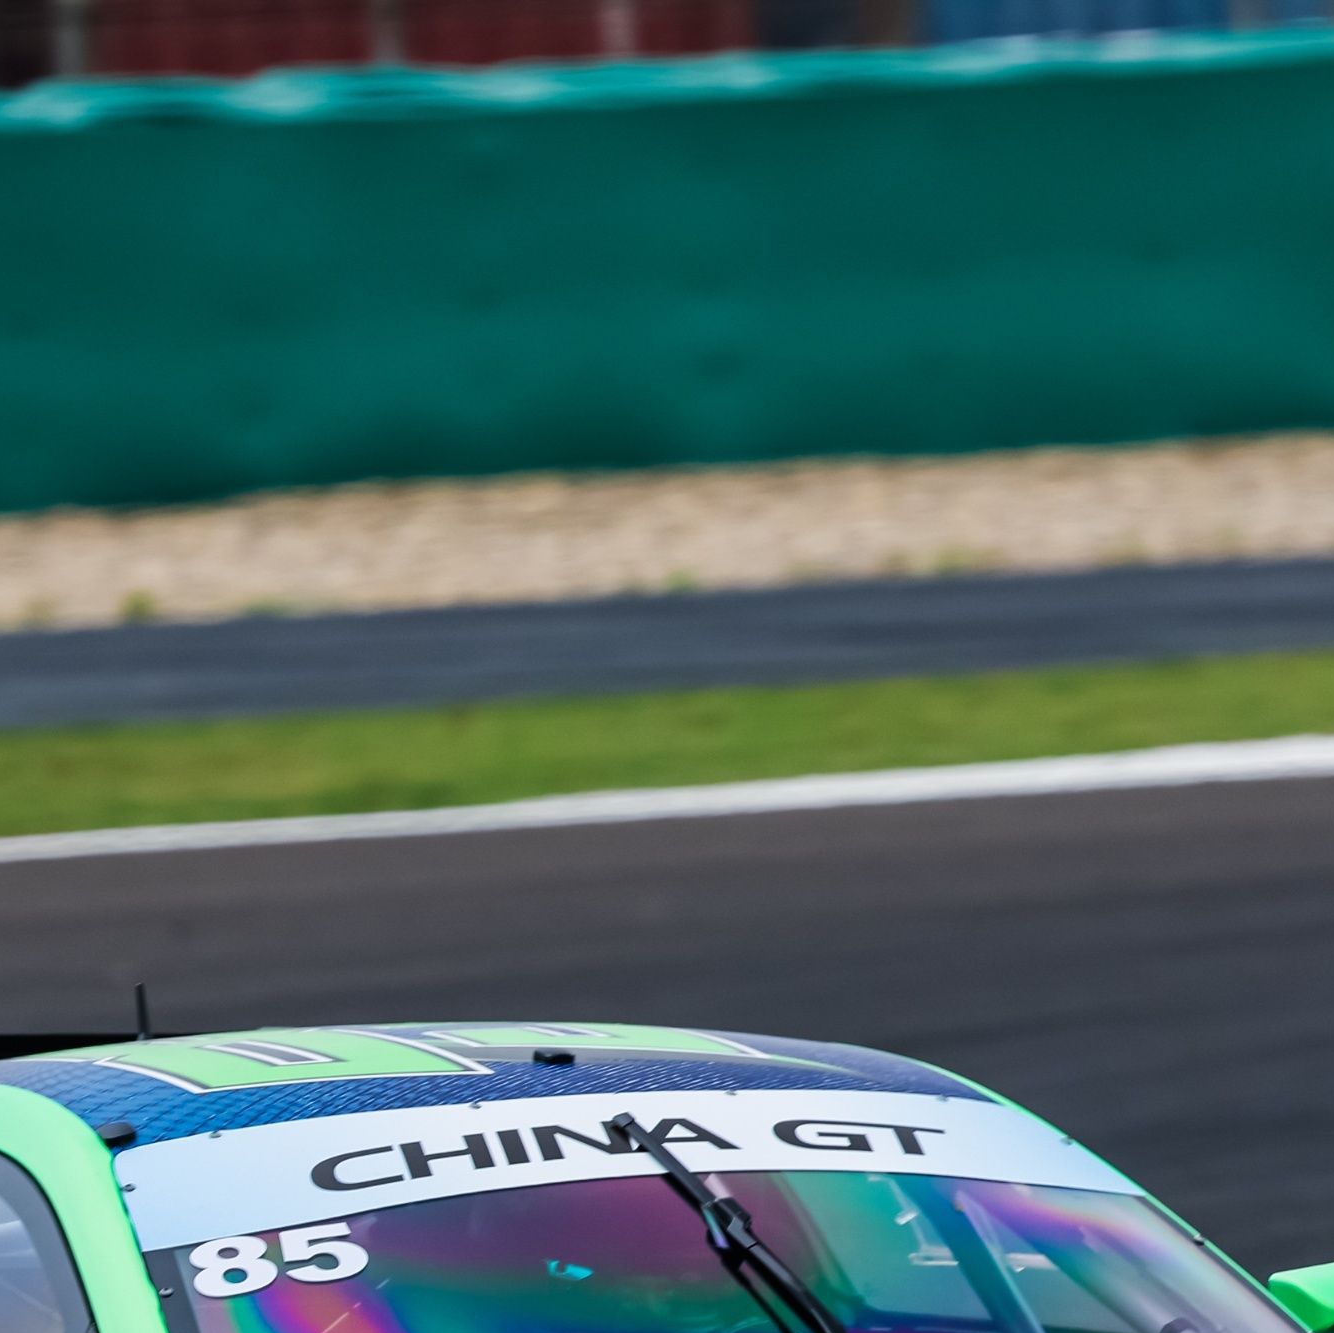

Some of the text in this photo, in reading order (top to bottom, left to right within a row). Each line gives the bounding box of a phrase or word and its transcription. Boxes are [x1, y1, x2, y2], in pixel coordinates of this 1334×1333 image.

[310, 1118, 946, 1191] CHINA GT
[189, 1222, 369, 1297] 85
